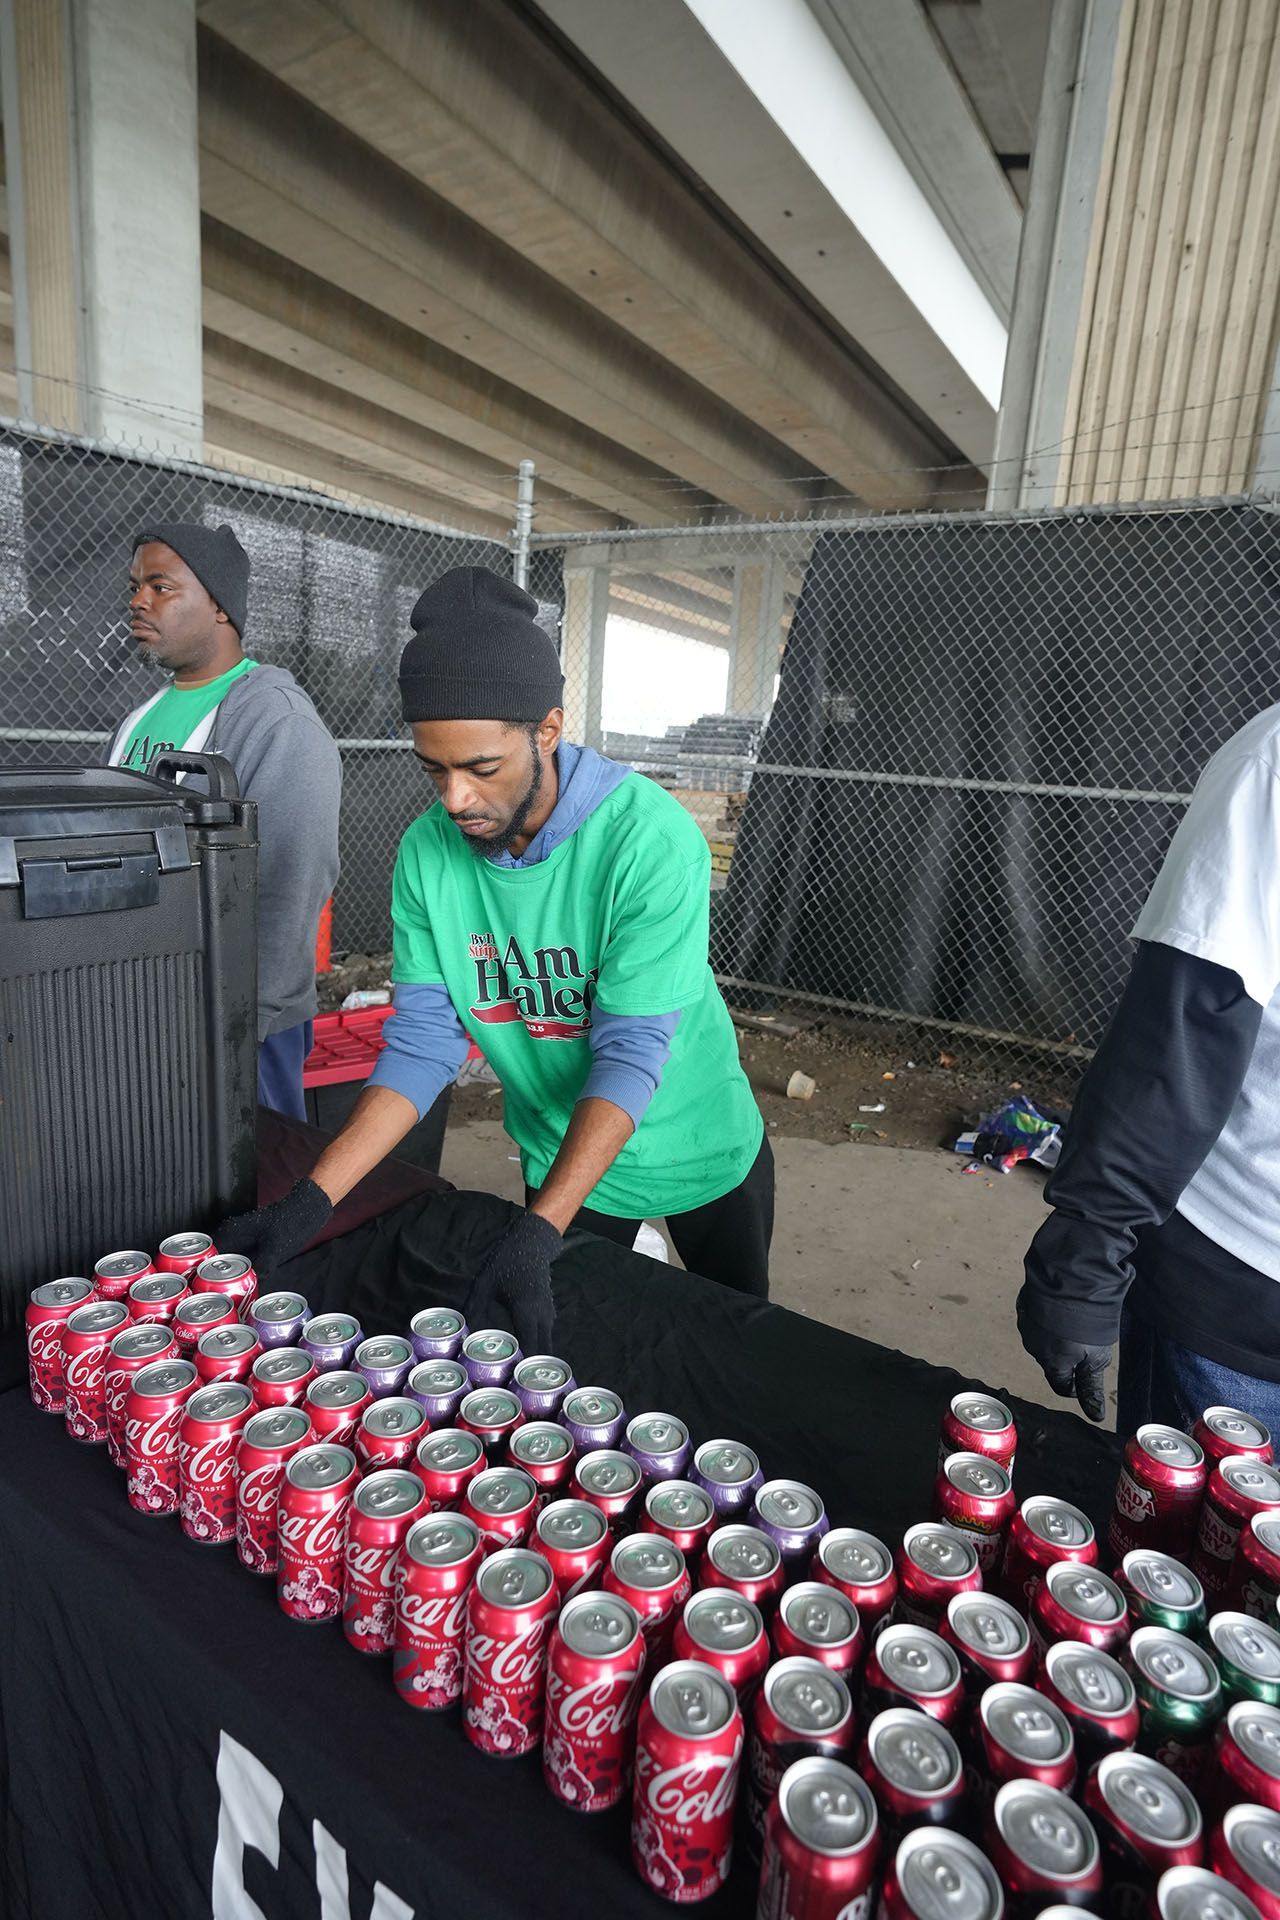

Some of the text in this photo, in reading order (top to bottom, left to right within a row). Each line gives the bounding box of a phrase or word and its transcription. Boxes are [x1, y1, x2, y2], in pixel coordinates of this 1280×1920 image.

[469, 943, 499, 960] Strip
[502, 934, 585, 980] Am
[175, 1326, 192, 1340] Coke
[152, 1455, 179, 1465] TASTE
[200, 1485, 226, 1493] TASTE
[1117, 1477, 1155, 1516] NADA
[247, 1512, 271, 1522] TASTE
[279, 1548, 315, 1566] ORIGINAL
[350, 1581, 391, 1599] ORIGINAL
[408, 1636, 454, 1651] ORIGINAL
[505, 1681, 536, 1696] TASTE
[572, 1736, 602, 1749] TASTE
[660, 1820, 692, 1836] TASTE
